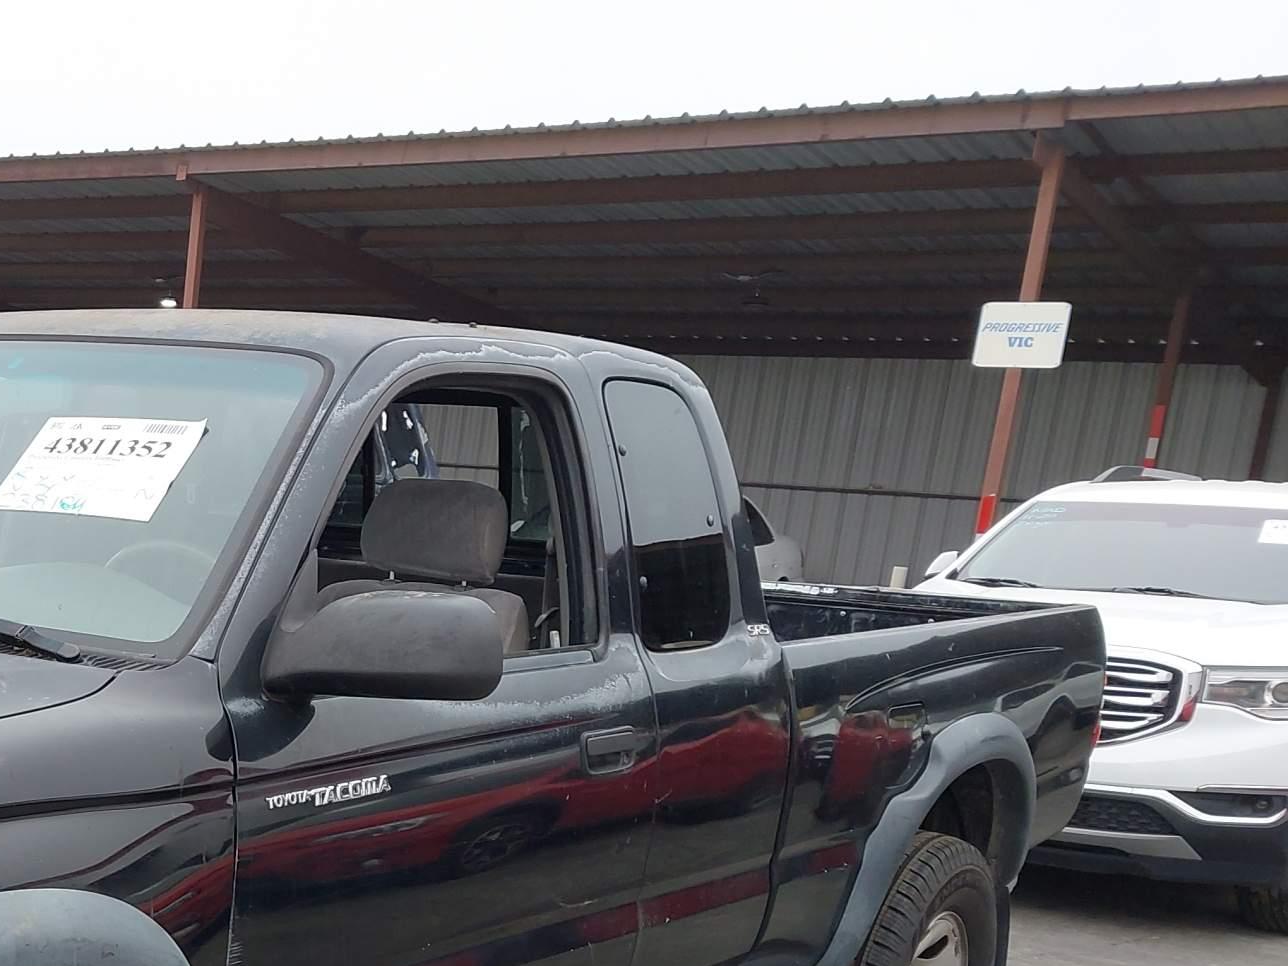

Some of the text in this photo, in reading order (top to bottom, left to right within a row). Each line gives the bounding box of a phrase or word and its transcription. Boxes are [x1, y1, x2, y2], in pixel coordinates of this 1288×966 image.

[982, 322, 1062, 333] PROGRESSIVE
[1007, 336, 1034, 348] VIC
[43, 437, 173, 458] 43811352
[266, 775, 391, 809] TOYOTA TACOMA
